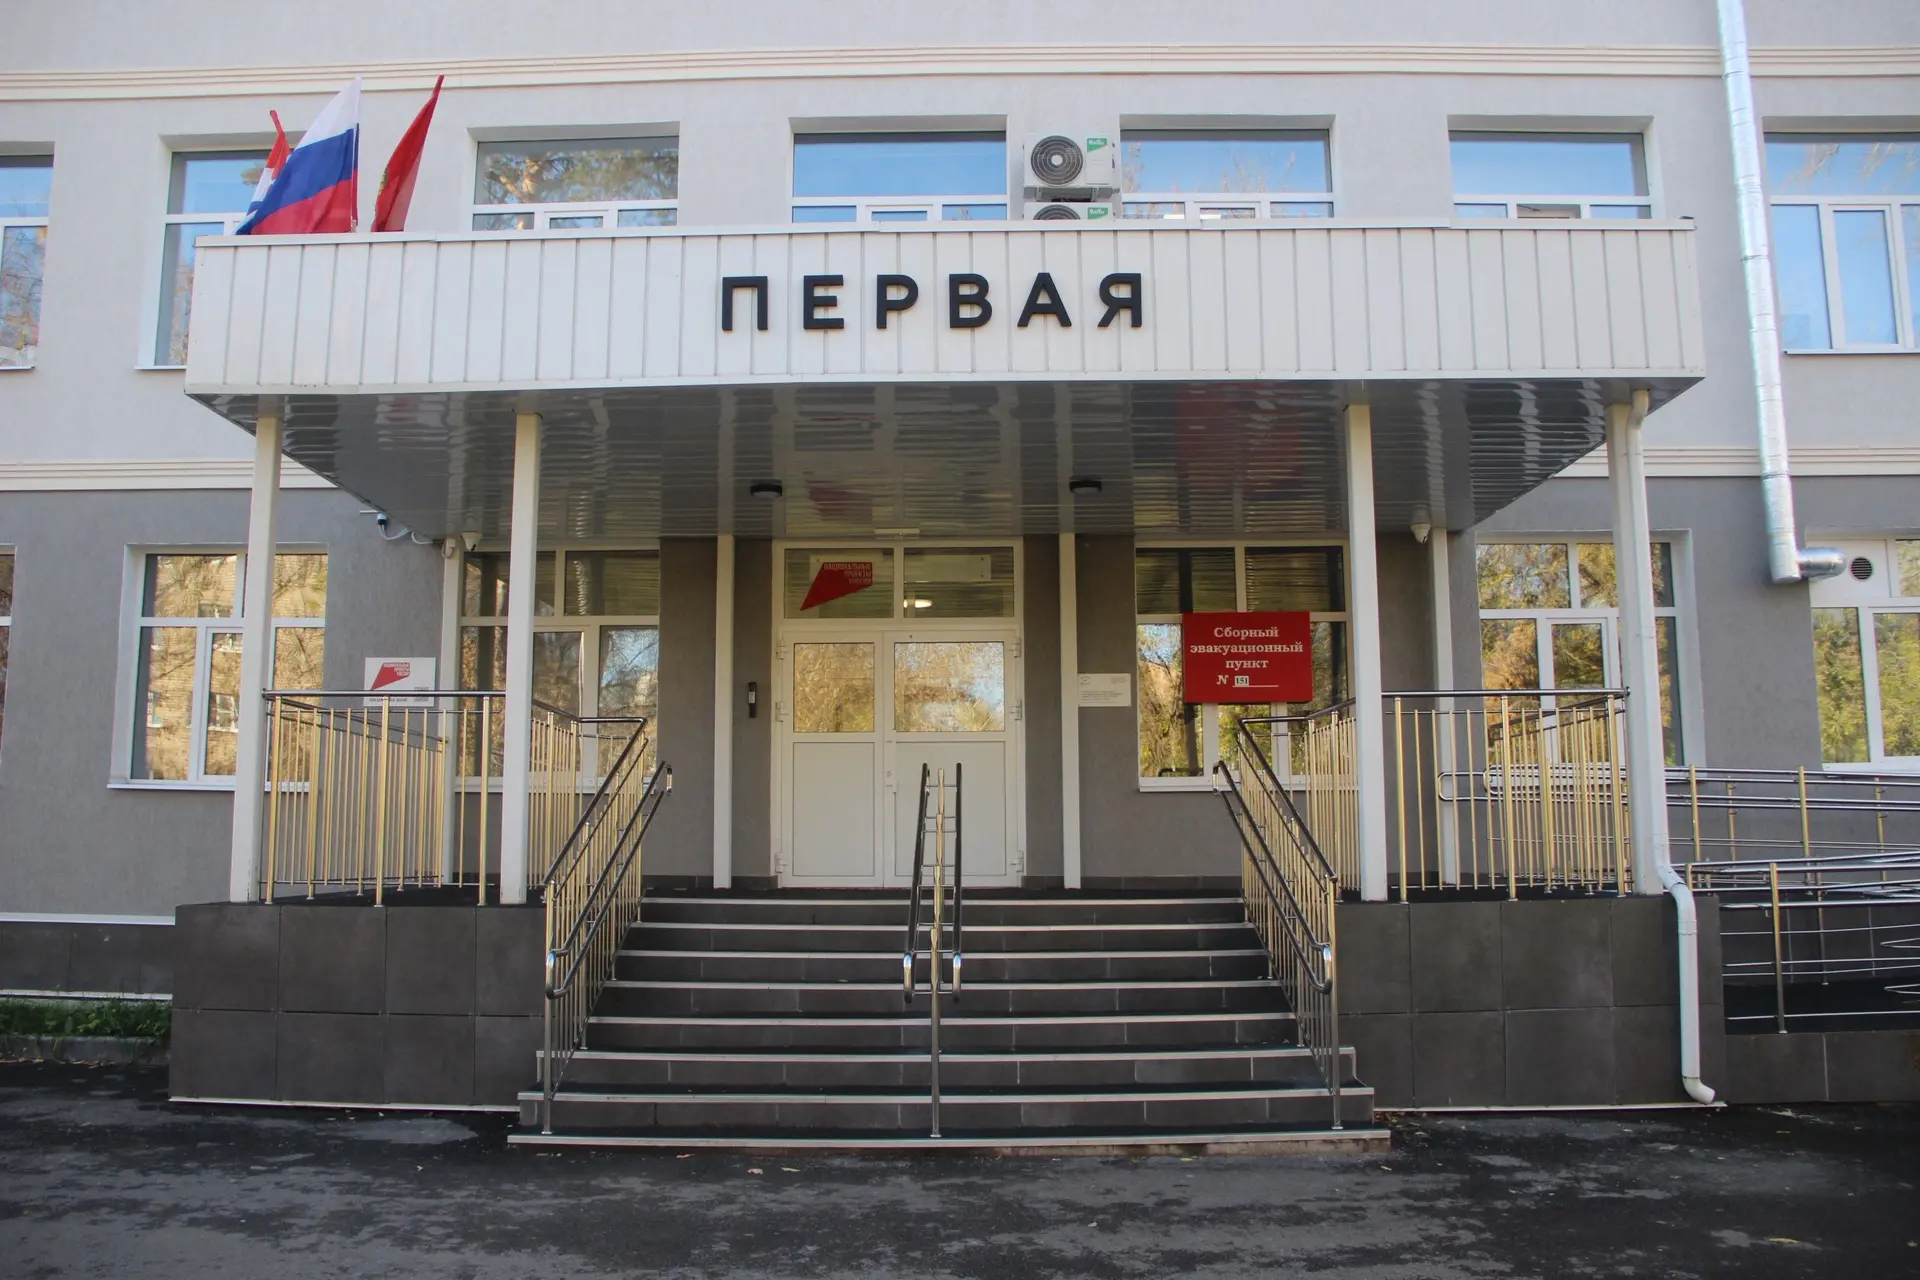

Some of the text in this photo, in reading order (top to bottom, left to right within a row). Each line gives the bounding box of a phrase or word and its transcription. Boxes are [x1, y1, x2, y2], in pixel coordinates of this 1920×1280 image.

[721, 272, 1142, 331] ПЕРВАЯ
[1213, 626, 1279, 640] Сборный
[1190, 641, 1304, 655] эвакуационный
[1225, 660, 1269, 671] пункт
[1235, 677, 1249, 685] 151
